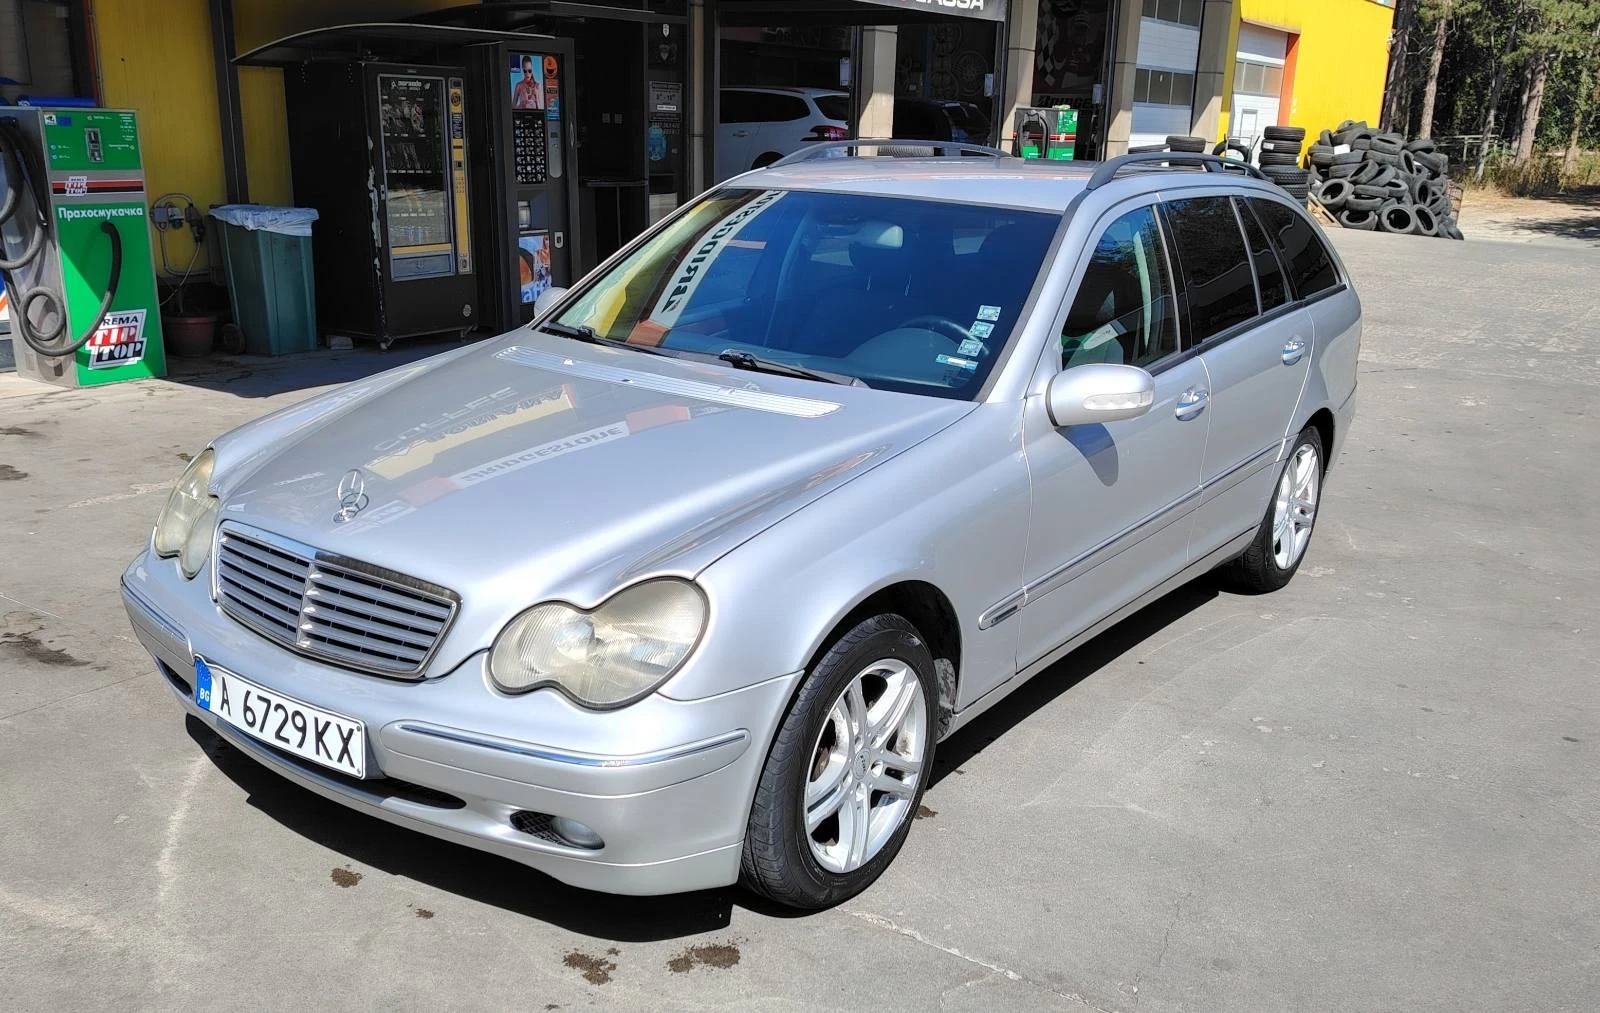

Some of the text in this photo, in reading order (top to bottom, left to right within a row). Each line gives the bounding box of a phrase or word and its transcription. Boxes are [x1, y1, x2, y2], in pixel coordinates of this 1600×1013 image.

[58, 207, 143, 222] Прахосмукачка
[102, 315, 138, 326] REMA
[95, 326, 136, 345] TIP
[99, 342, 142, 361] TOP
[200, 688, 210, 702] BG
[242, 690, 307, 749] 6729
